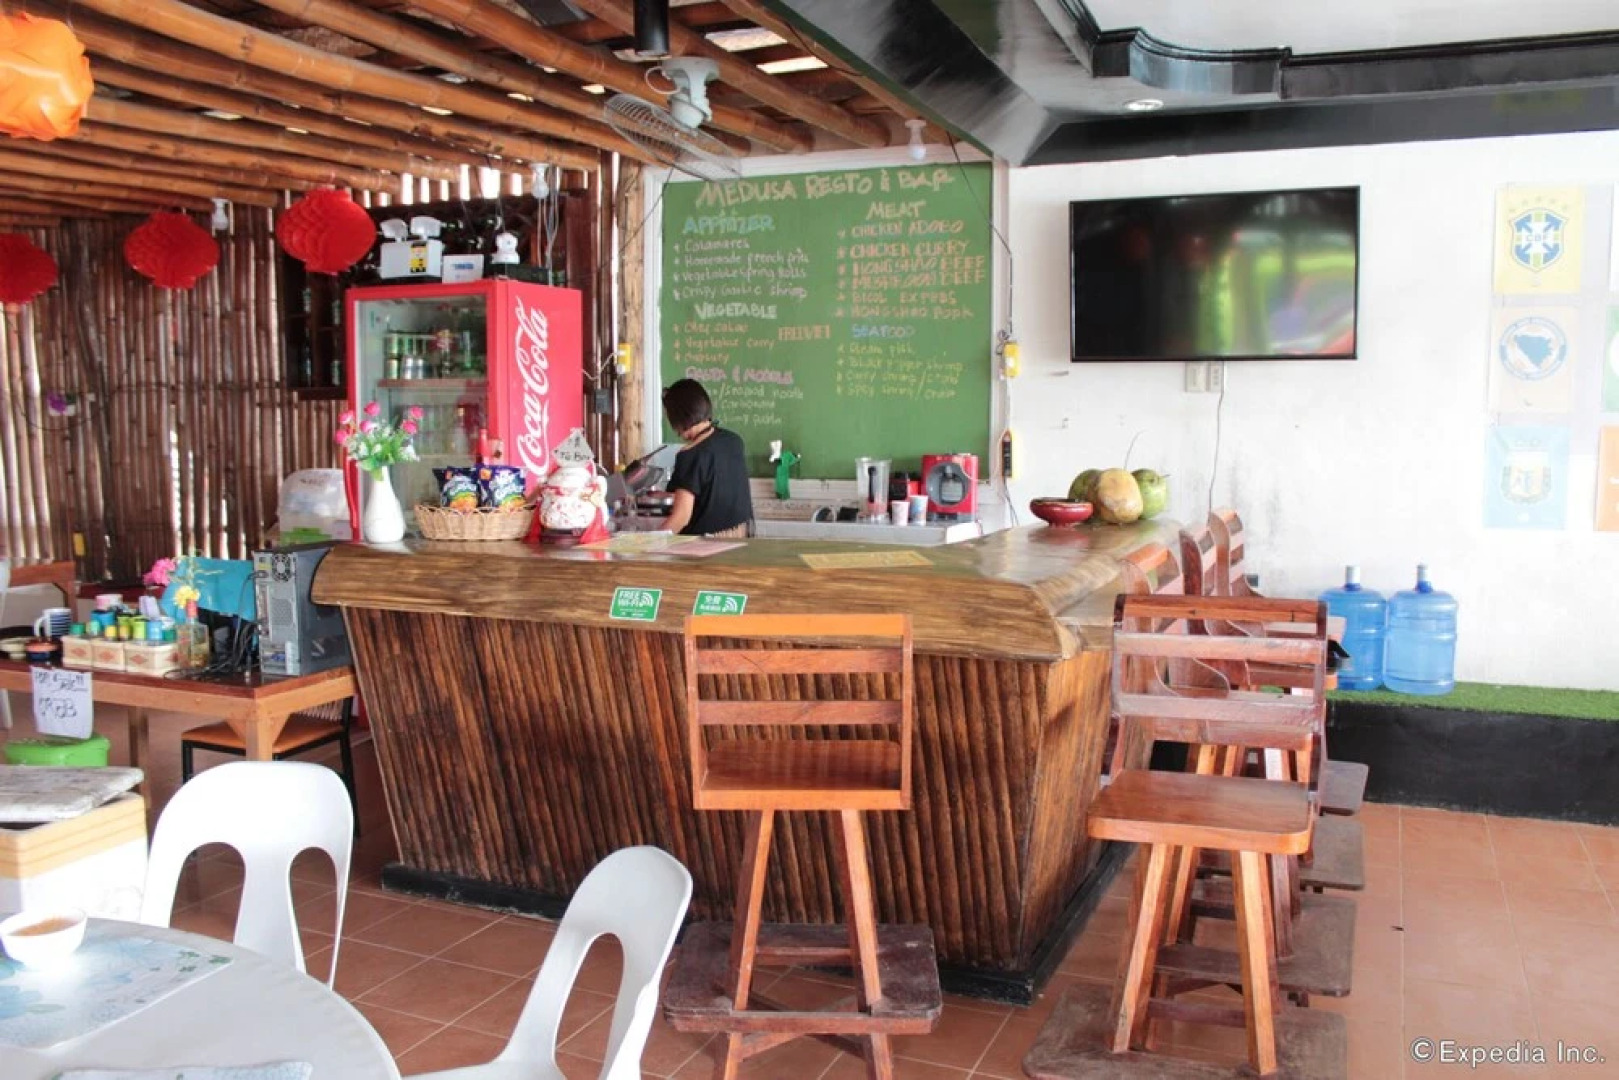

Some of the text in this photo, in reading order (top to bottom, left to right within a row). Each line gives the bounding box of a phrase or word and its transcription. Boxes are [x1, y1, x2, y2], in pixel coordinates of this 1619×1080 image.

[696, 180, 797, 208] MEDUSA
[805, 172, 873, 199] RESTO
[866, 201, 926, 220] MEAT
[851, 221, 902, 237] CHICKEN
[850, 240, 969, 258] CHICKEN CURRY
[694, 302, 778, 319] VEGETABLE
[515, 296, 550, 477] Coca-Cola
